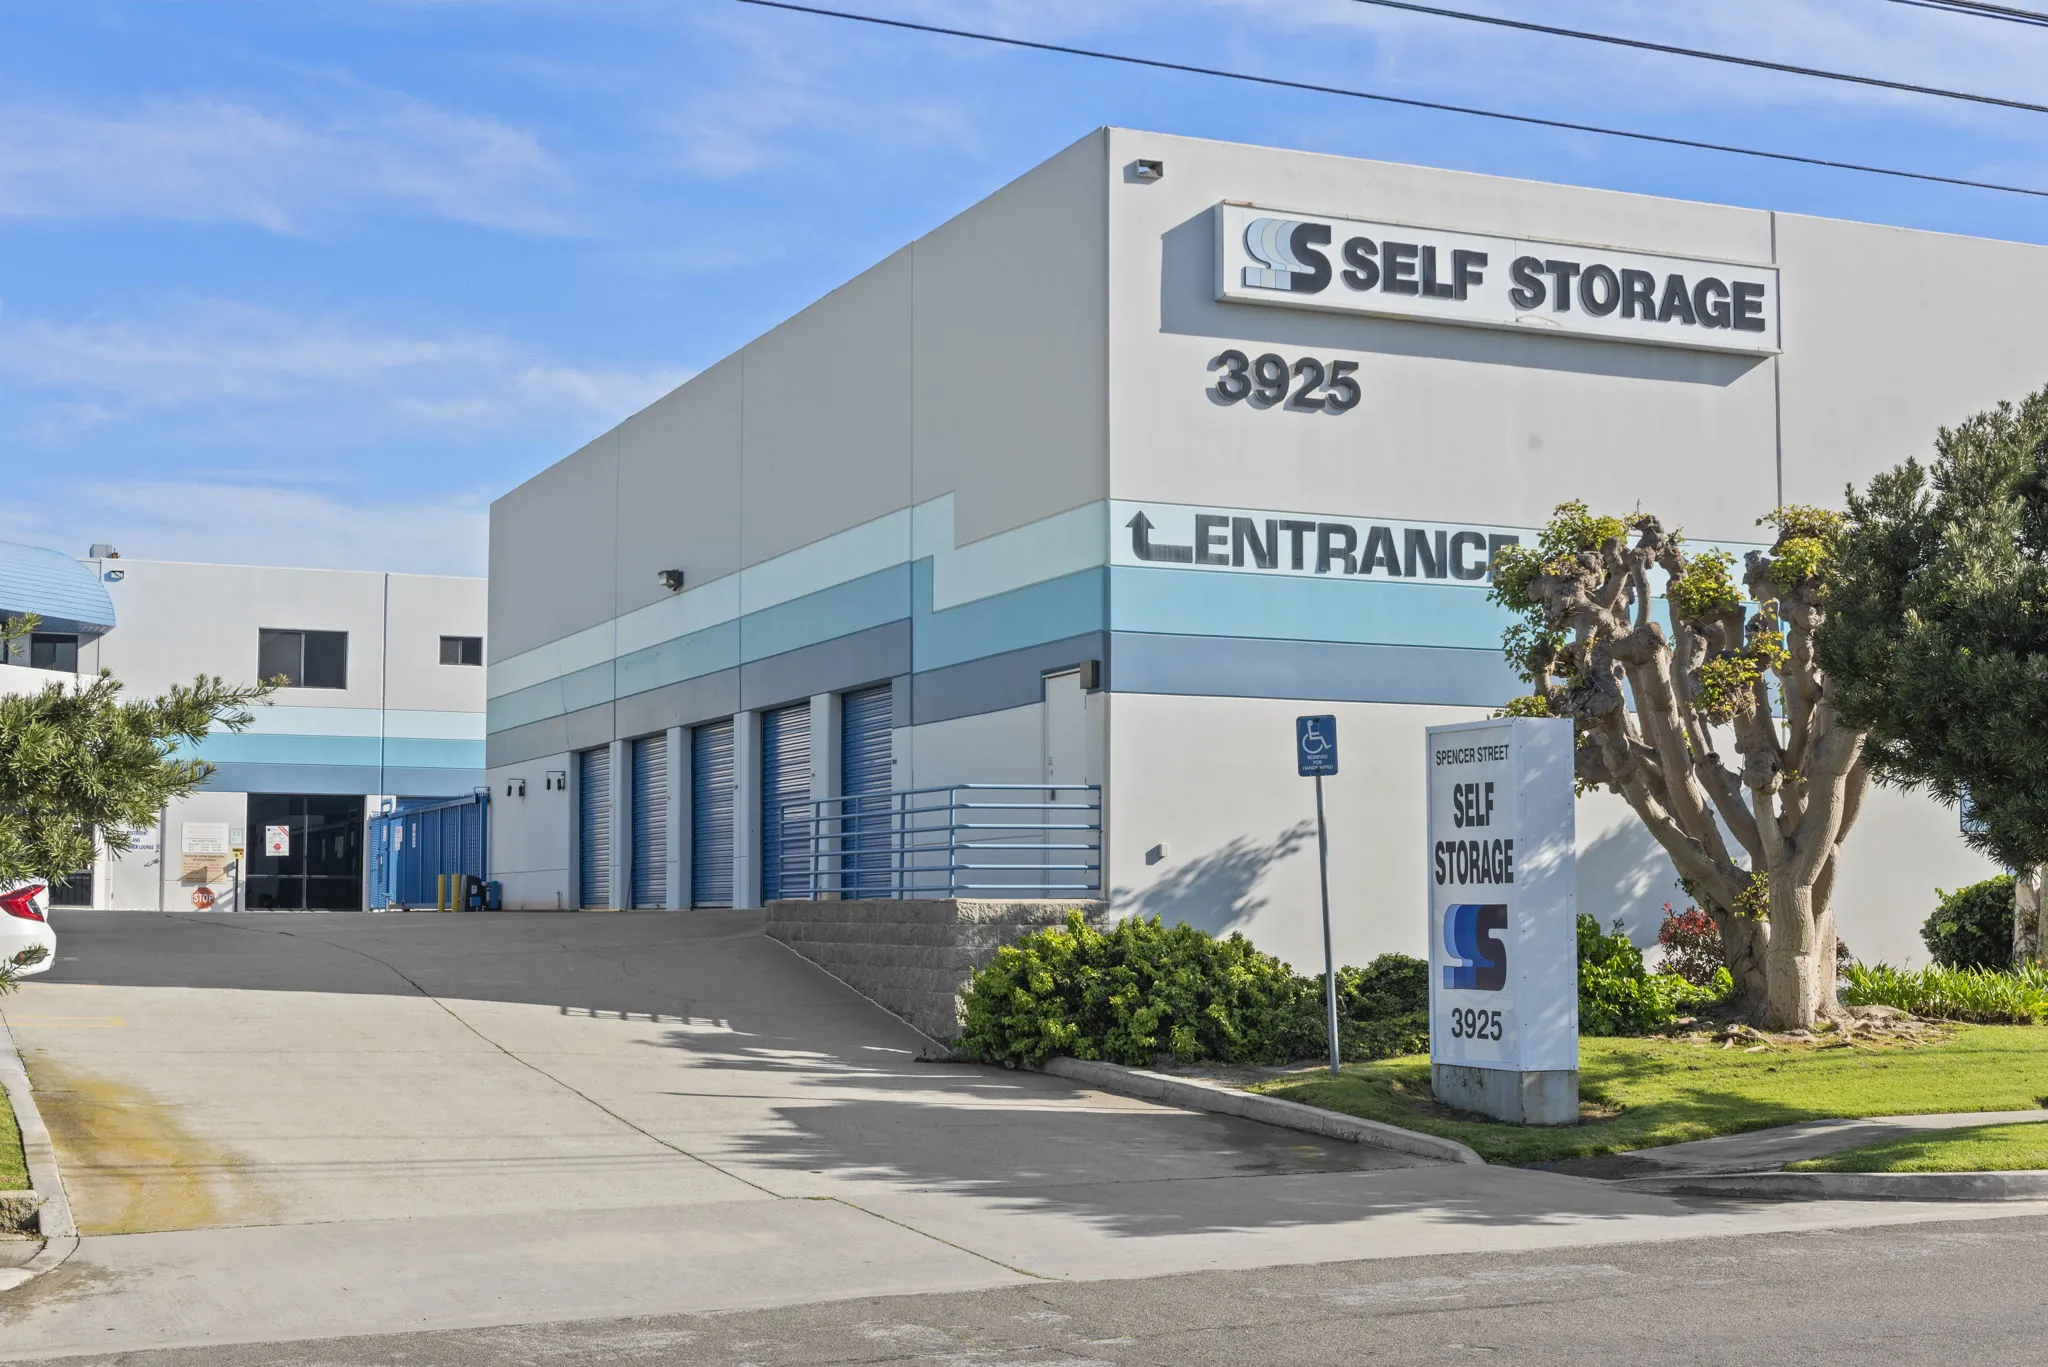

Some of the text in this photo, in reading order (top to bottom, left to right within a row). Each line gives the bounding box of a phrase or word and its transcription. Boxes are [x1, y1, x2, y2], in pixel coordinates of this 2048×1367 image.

[1341, 236, 1766, 333] SELF STORAGE
[1214, 349, 1362, 411] 3925
[1436, 744, 1510, 766] SPENCER STREET
[1453, 781, 1494, 829] SELF
[1435, 838, 1514, 885] STORAGE
[193, 893, 214, 903] STOP
[1451, 1007, 1503, 1041] 3925
